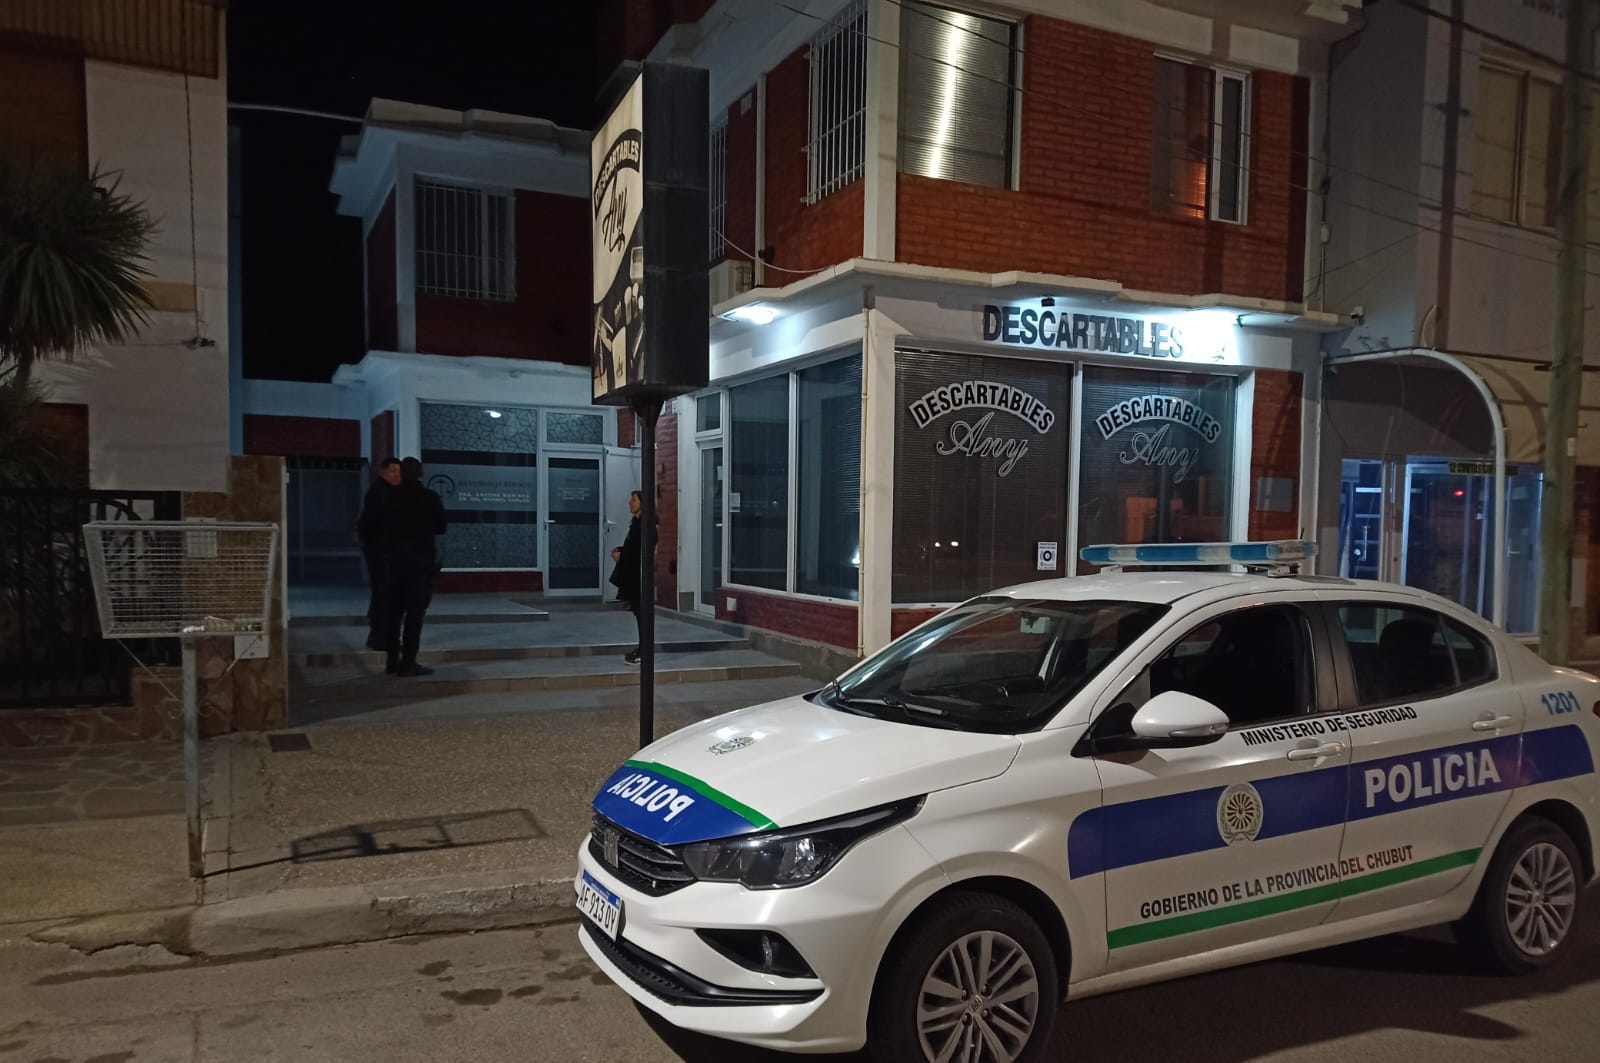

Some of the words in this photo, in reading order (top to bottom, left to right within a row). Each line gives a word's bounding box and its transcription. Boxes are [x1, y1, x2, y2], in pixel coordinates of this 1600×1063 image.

[595, 139, 639, 207] DESCARTABLES
[602, 174, 626, 252] Any
[983, 304, 1184, 358] DESCARTABLES
[909, 381, 1055, 434] DESCARTABLES
[1096, 394, 1221, 443] DESCARTABLES
[936, 411, 1028, 477] Any
[1120, 423, 1198, 484] Any
[1239, 719, 1325, 746] MINISTERIO
[1325, 717, 1346, 732] DE
[1346, 706, 1418, 729] SEGURIDAD
[1541, 690, 1581, 716] 1201
[1364, 748, 1502, 808] POLICIA
[578, 884, 590, 907] AF
[589, 893, 605, 922] 913
[1140, 888, 1219, 919] GOBIERNO
[1223, 884, 1242, 902] DE
[1245, 879, 1264, 897] LA
[1266, 862, 1339, 893] PROVINCIA
[1340, 857, 1365, 876] DEL
[1366, 845, 1414, 870] CHUBUT
